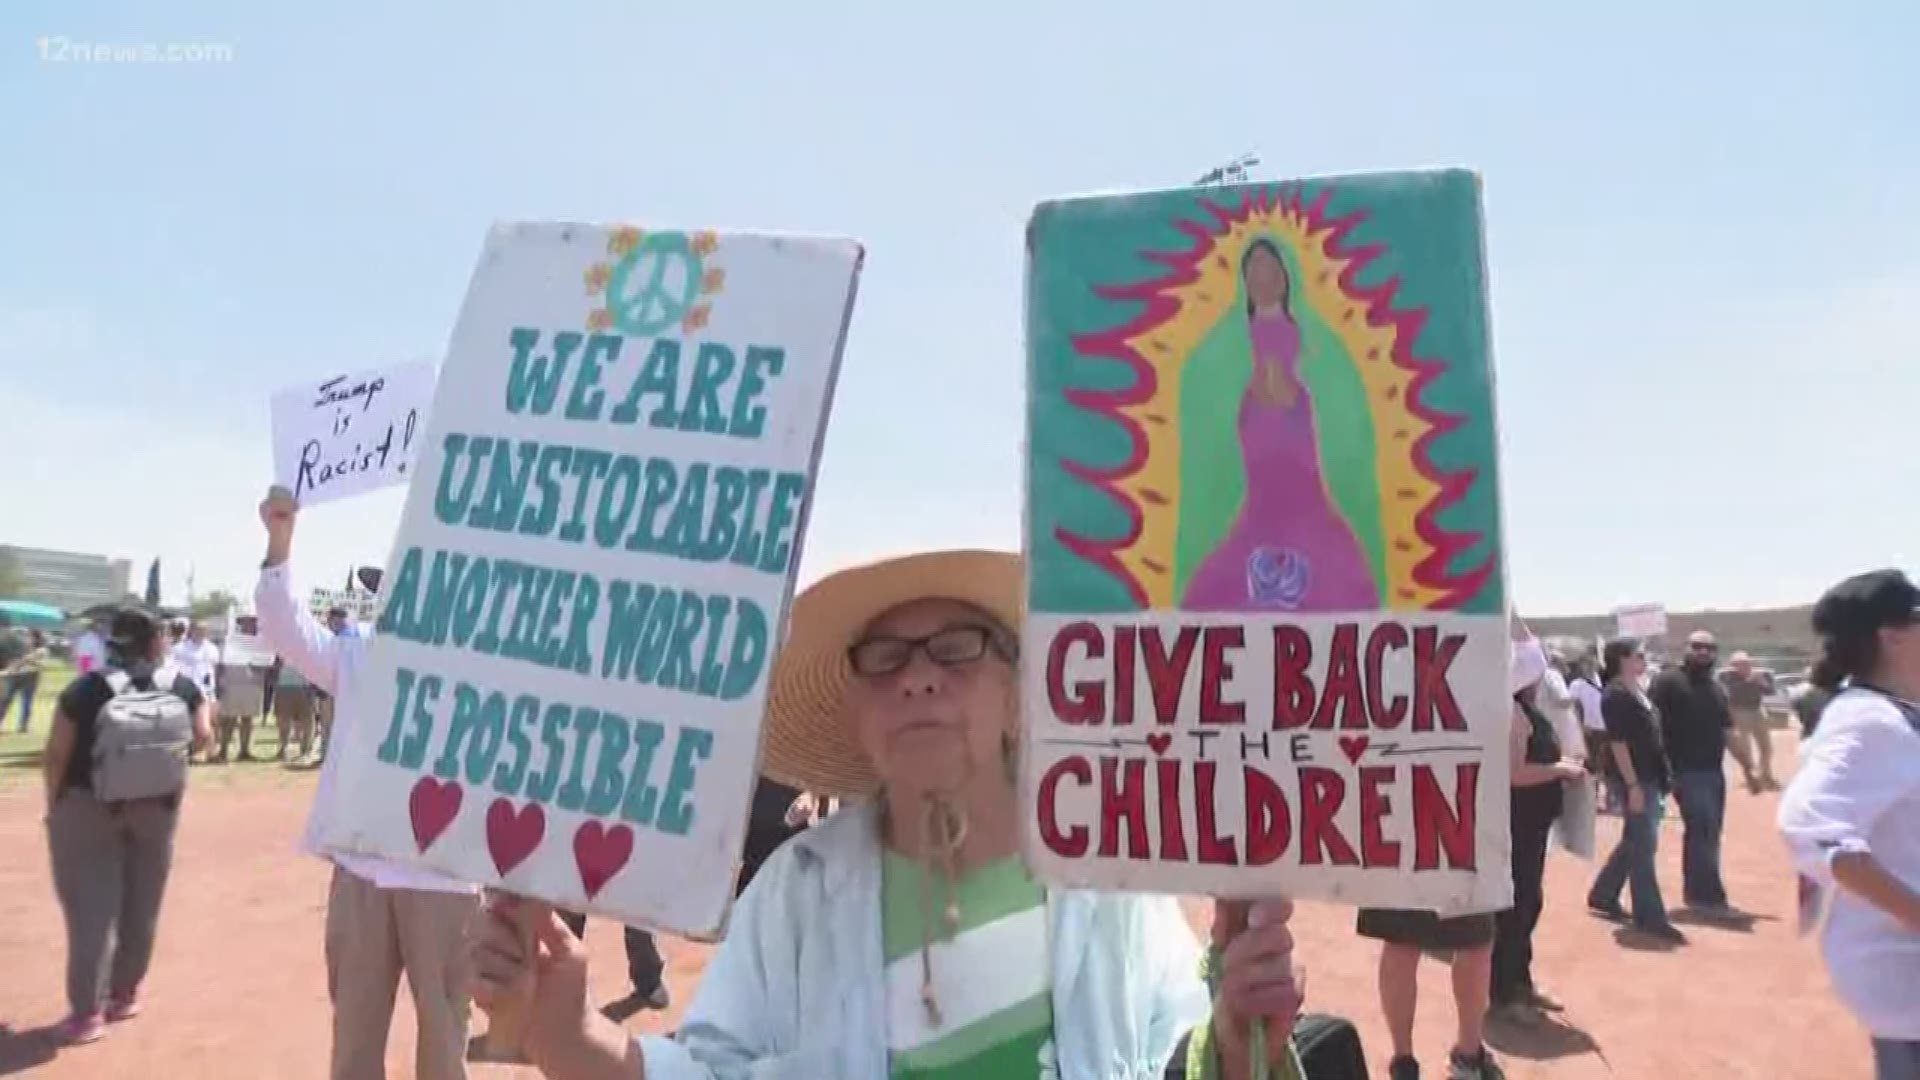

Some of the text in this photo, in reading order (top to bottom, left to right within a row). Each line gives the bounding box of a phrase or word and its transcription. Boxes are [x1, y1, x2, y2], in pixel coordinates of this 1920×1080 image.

[314, 375, 385, 412] Trump
[333, 407, 351, 436] is
[505, 327, 784, 439] WE ARE
[295, 408, 416, 502] Racist!
[434, 433, 806, 575] UNSTOPABLE
[379, 547, 769, 701] ANOTHER WORLD
[1045, 620, 1468, 732] GIVE BACK
[377, 667, 714, 836] IS POSSIBLE
[1187, 730, 1314, 762] THE
[1036, 754, 1481, 871] CHILDREN
